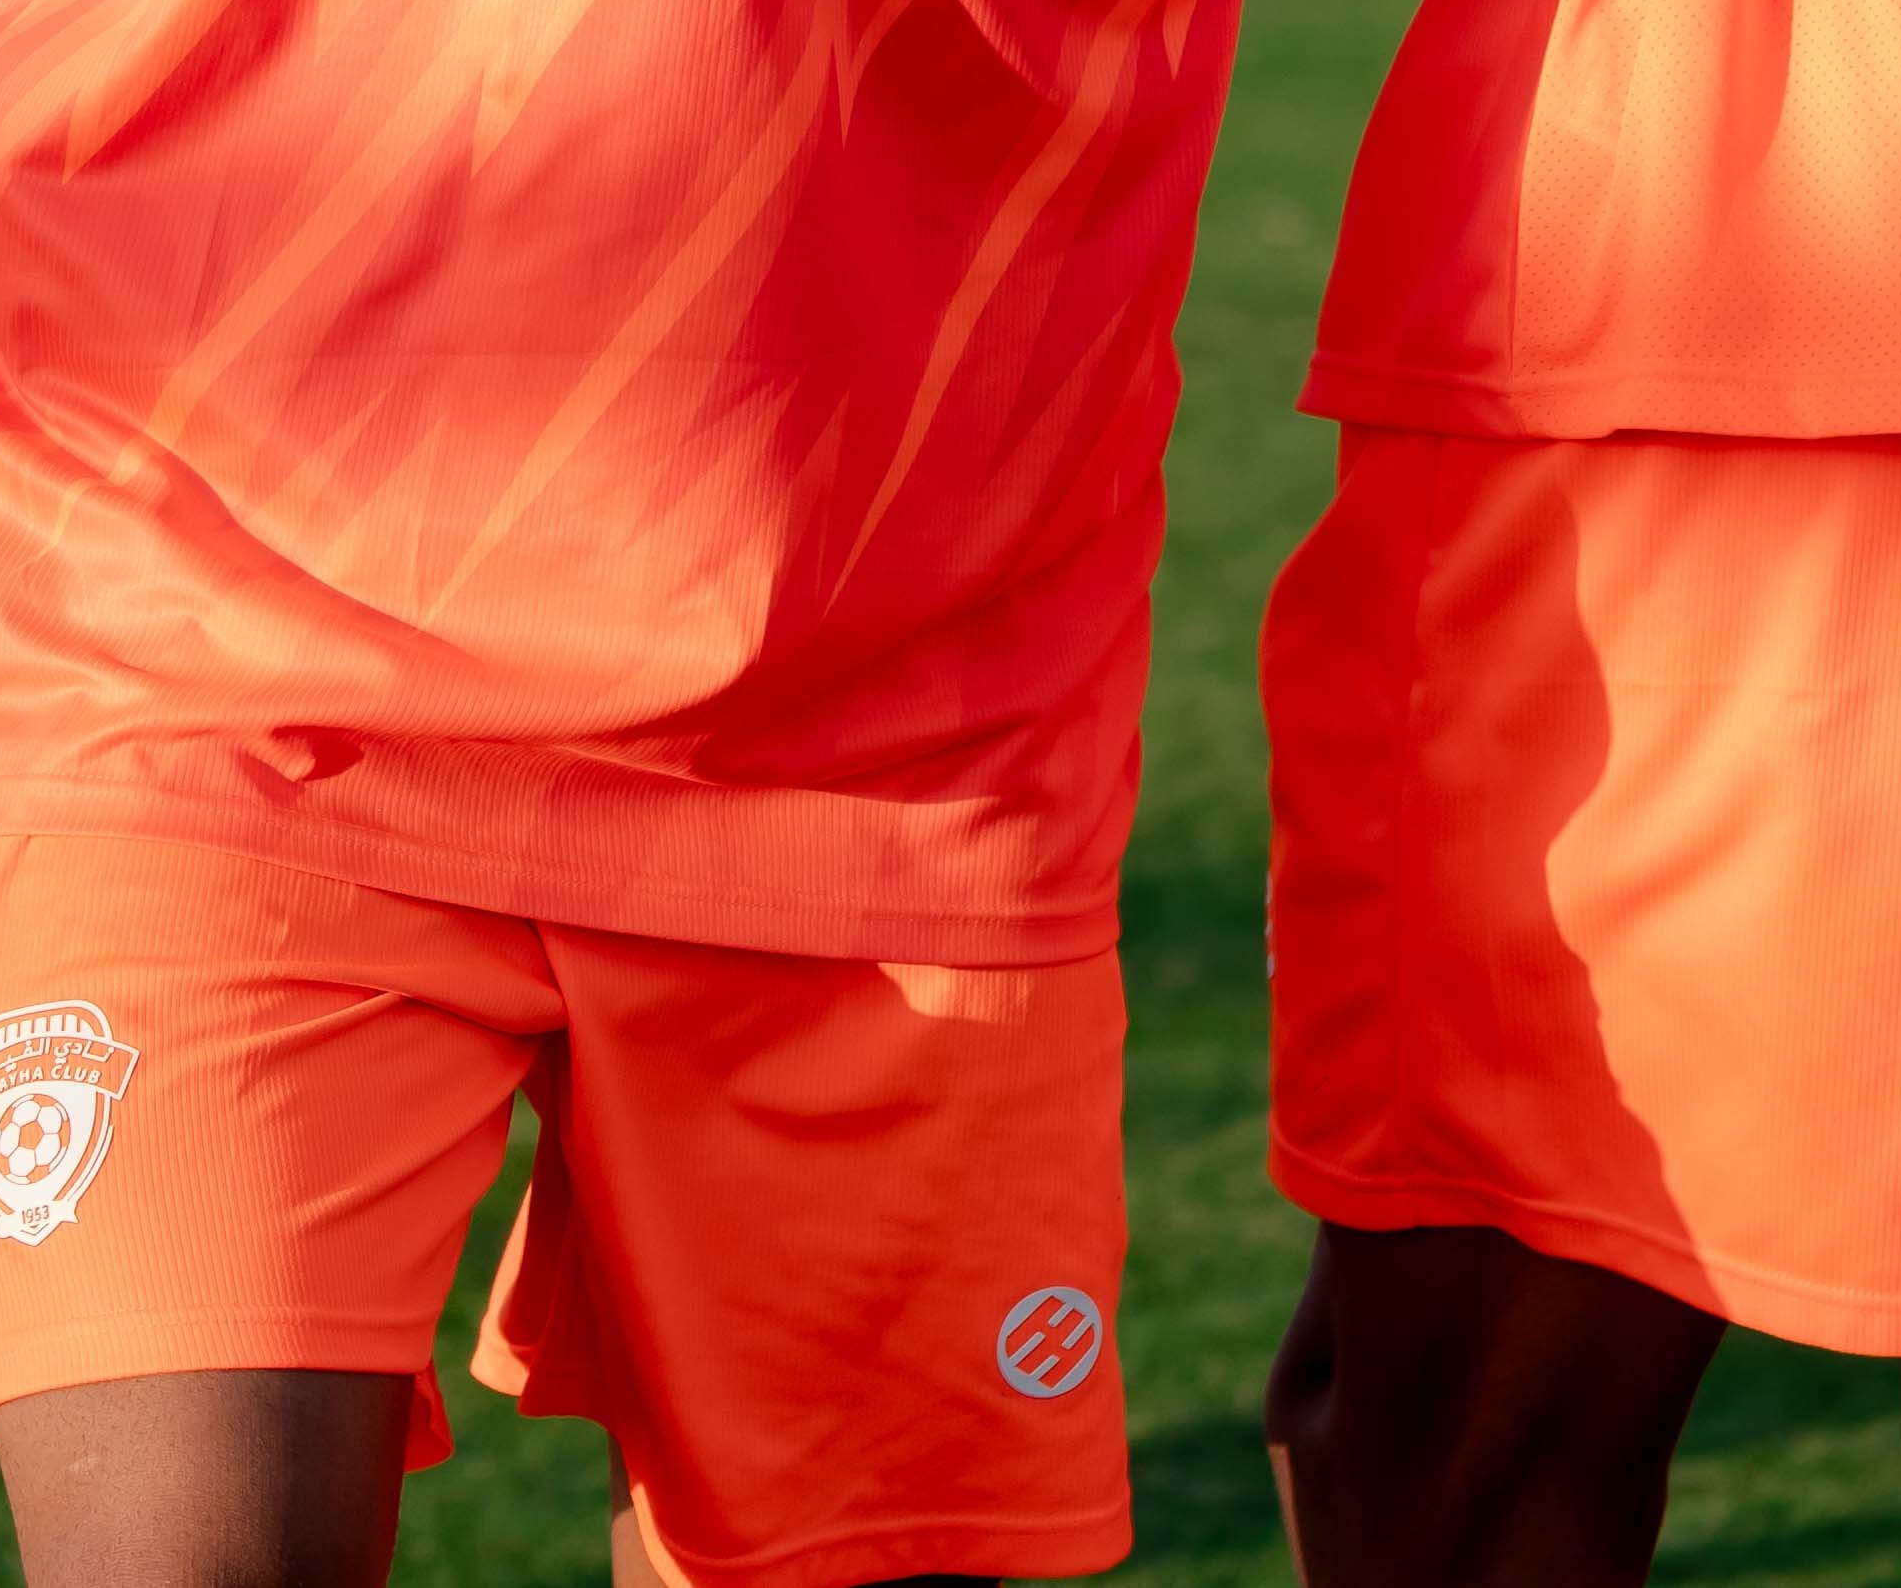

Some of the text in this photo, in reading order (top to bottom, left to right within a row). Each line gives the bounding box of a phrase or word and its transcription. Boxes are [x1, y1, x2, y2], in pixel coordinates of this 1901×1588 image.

[54, 1039, 115, 1065] نادي
[51, 1064, 101, 1084] CLUB
[22, 1205, 49, 1224] 1953
